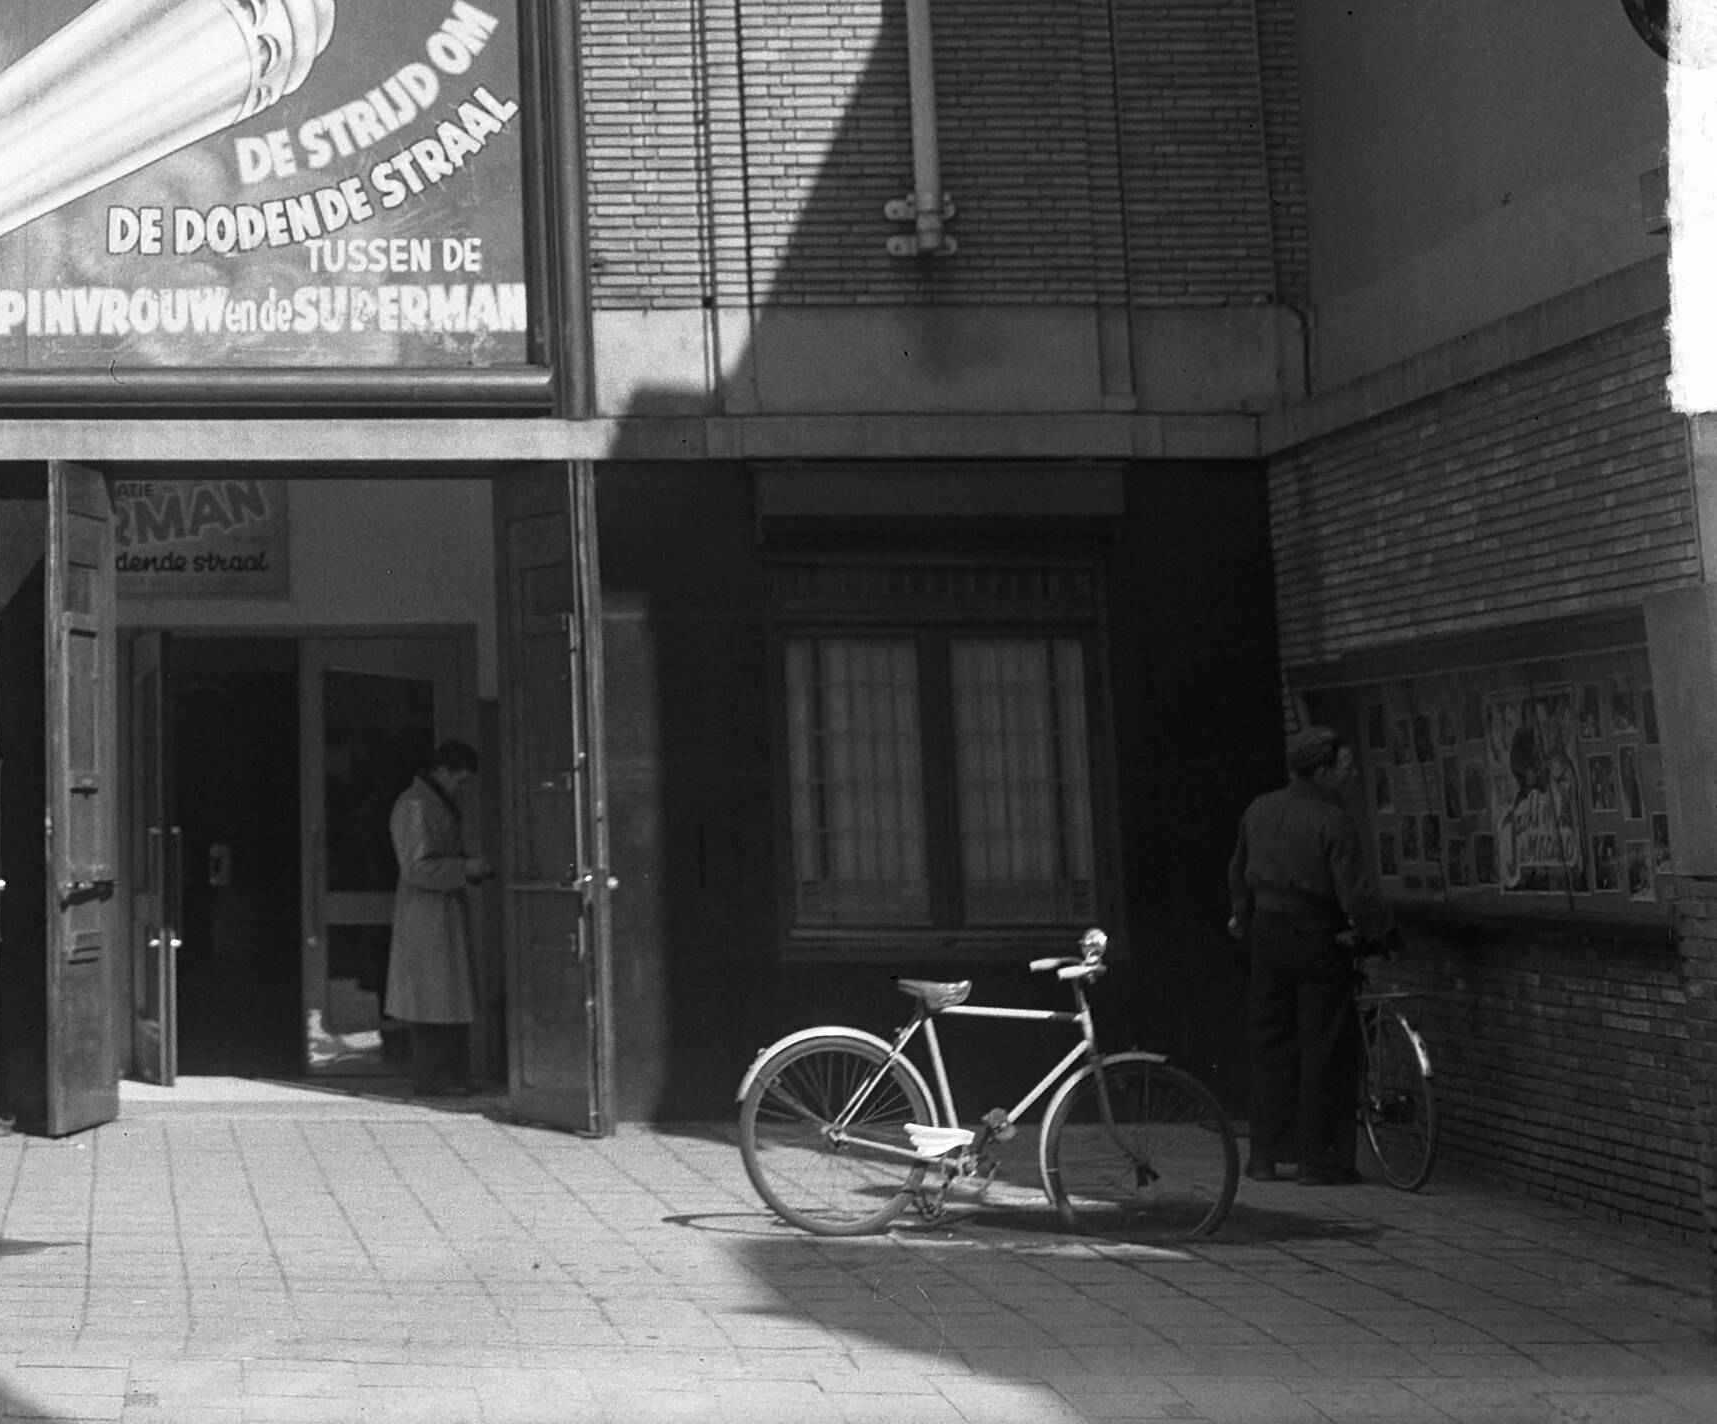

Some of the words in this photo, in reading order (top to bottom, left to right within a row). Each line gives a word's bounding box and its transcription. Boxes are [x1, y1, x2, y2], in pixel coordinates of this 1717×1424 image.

[233, 130, 298, 185] DE
[297, 61, 441, 170] STRIJD
[106, 205, 163, 256] DE
[370, 85, 521, 211] STRAAL
[303, 237, 432, 276] TUSSEN
[442, 236, 483, 275] DE
[292, 282, 528, 334] SUPERMAN
[191, 549, 270, 573] straal
